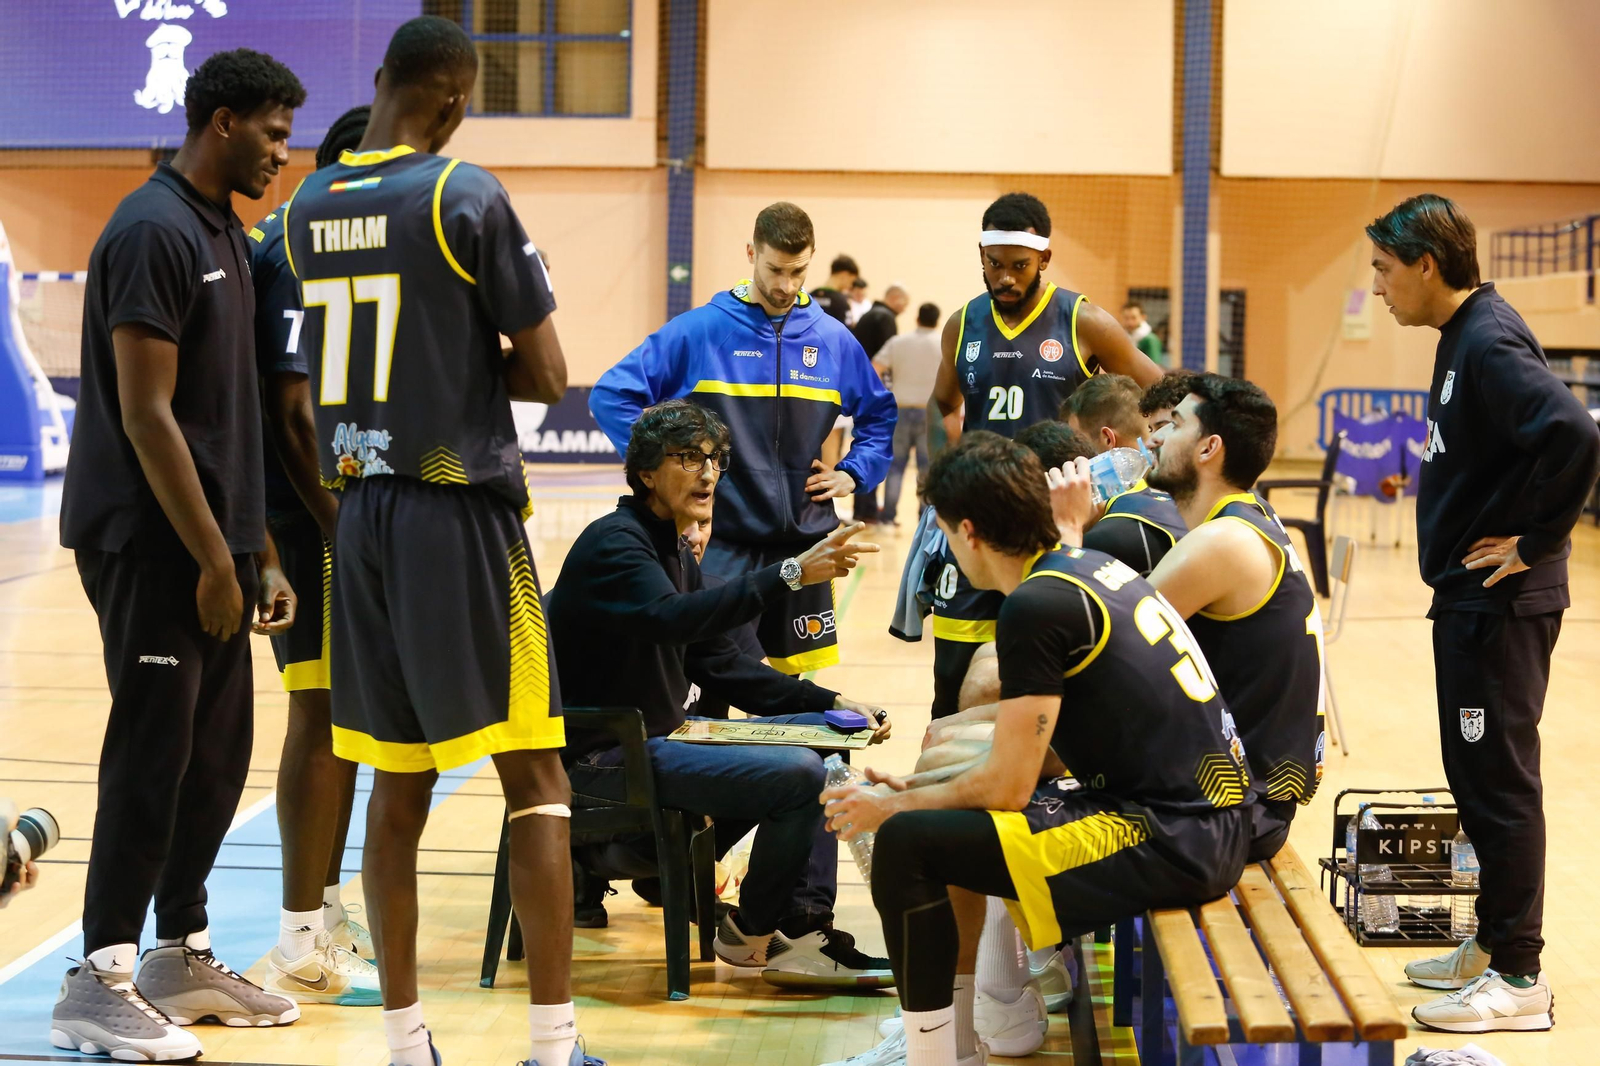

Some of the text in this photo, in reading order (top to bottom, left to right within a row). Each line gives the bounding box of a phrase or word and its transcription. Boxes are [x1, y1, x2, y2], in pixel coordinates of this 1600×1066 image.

[309, 215, 387, 253] THIAM
[302, 273, 401, 406] 77
[988, 385, 1024, 421] 20
[934, 563, 959, 600] 0
[1134, 590, 1219, 703] 3
[1379, 839, 1453, 855] KIPST
